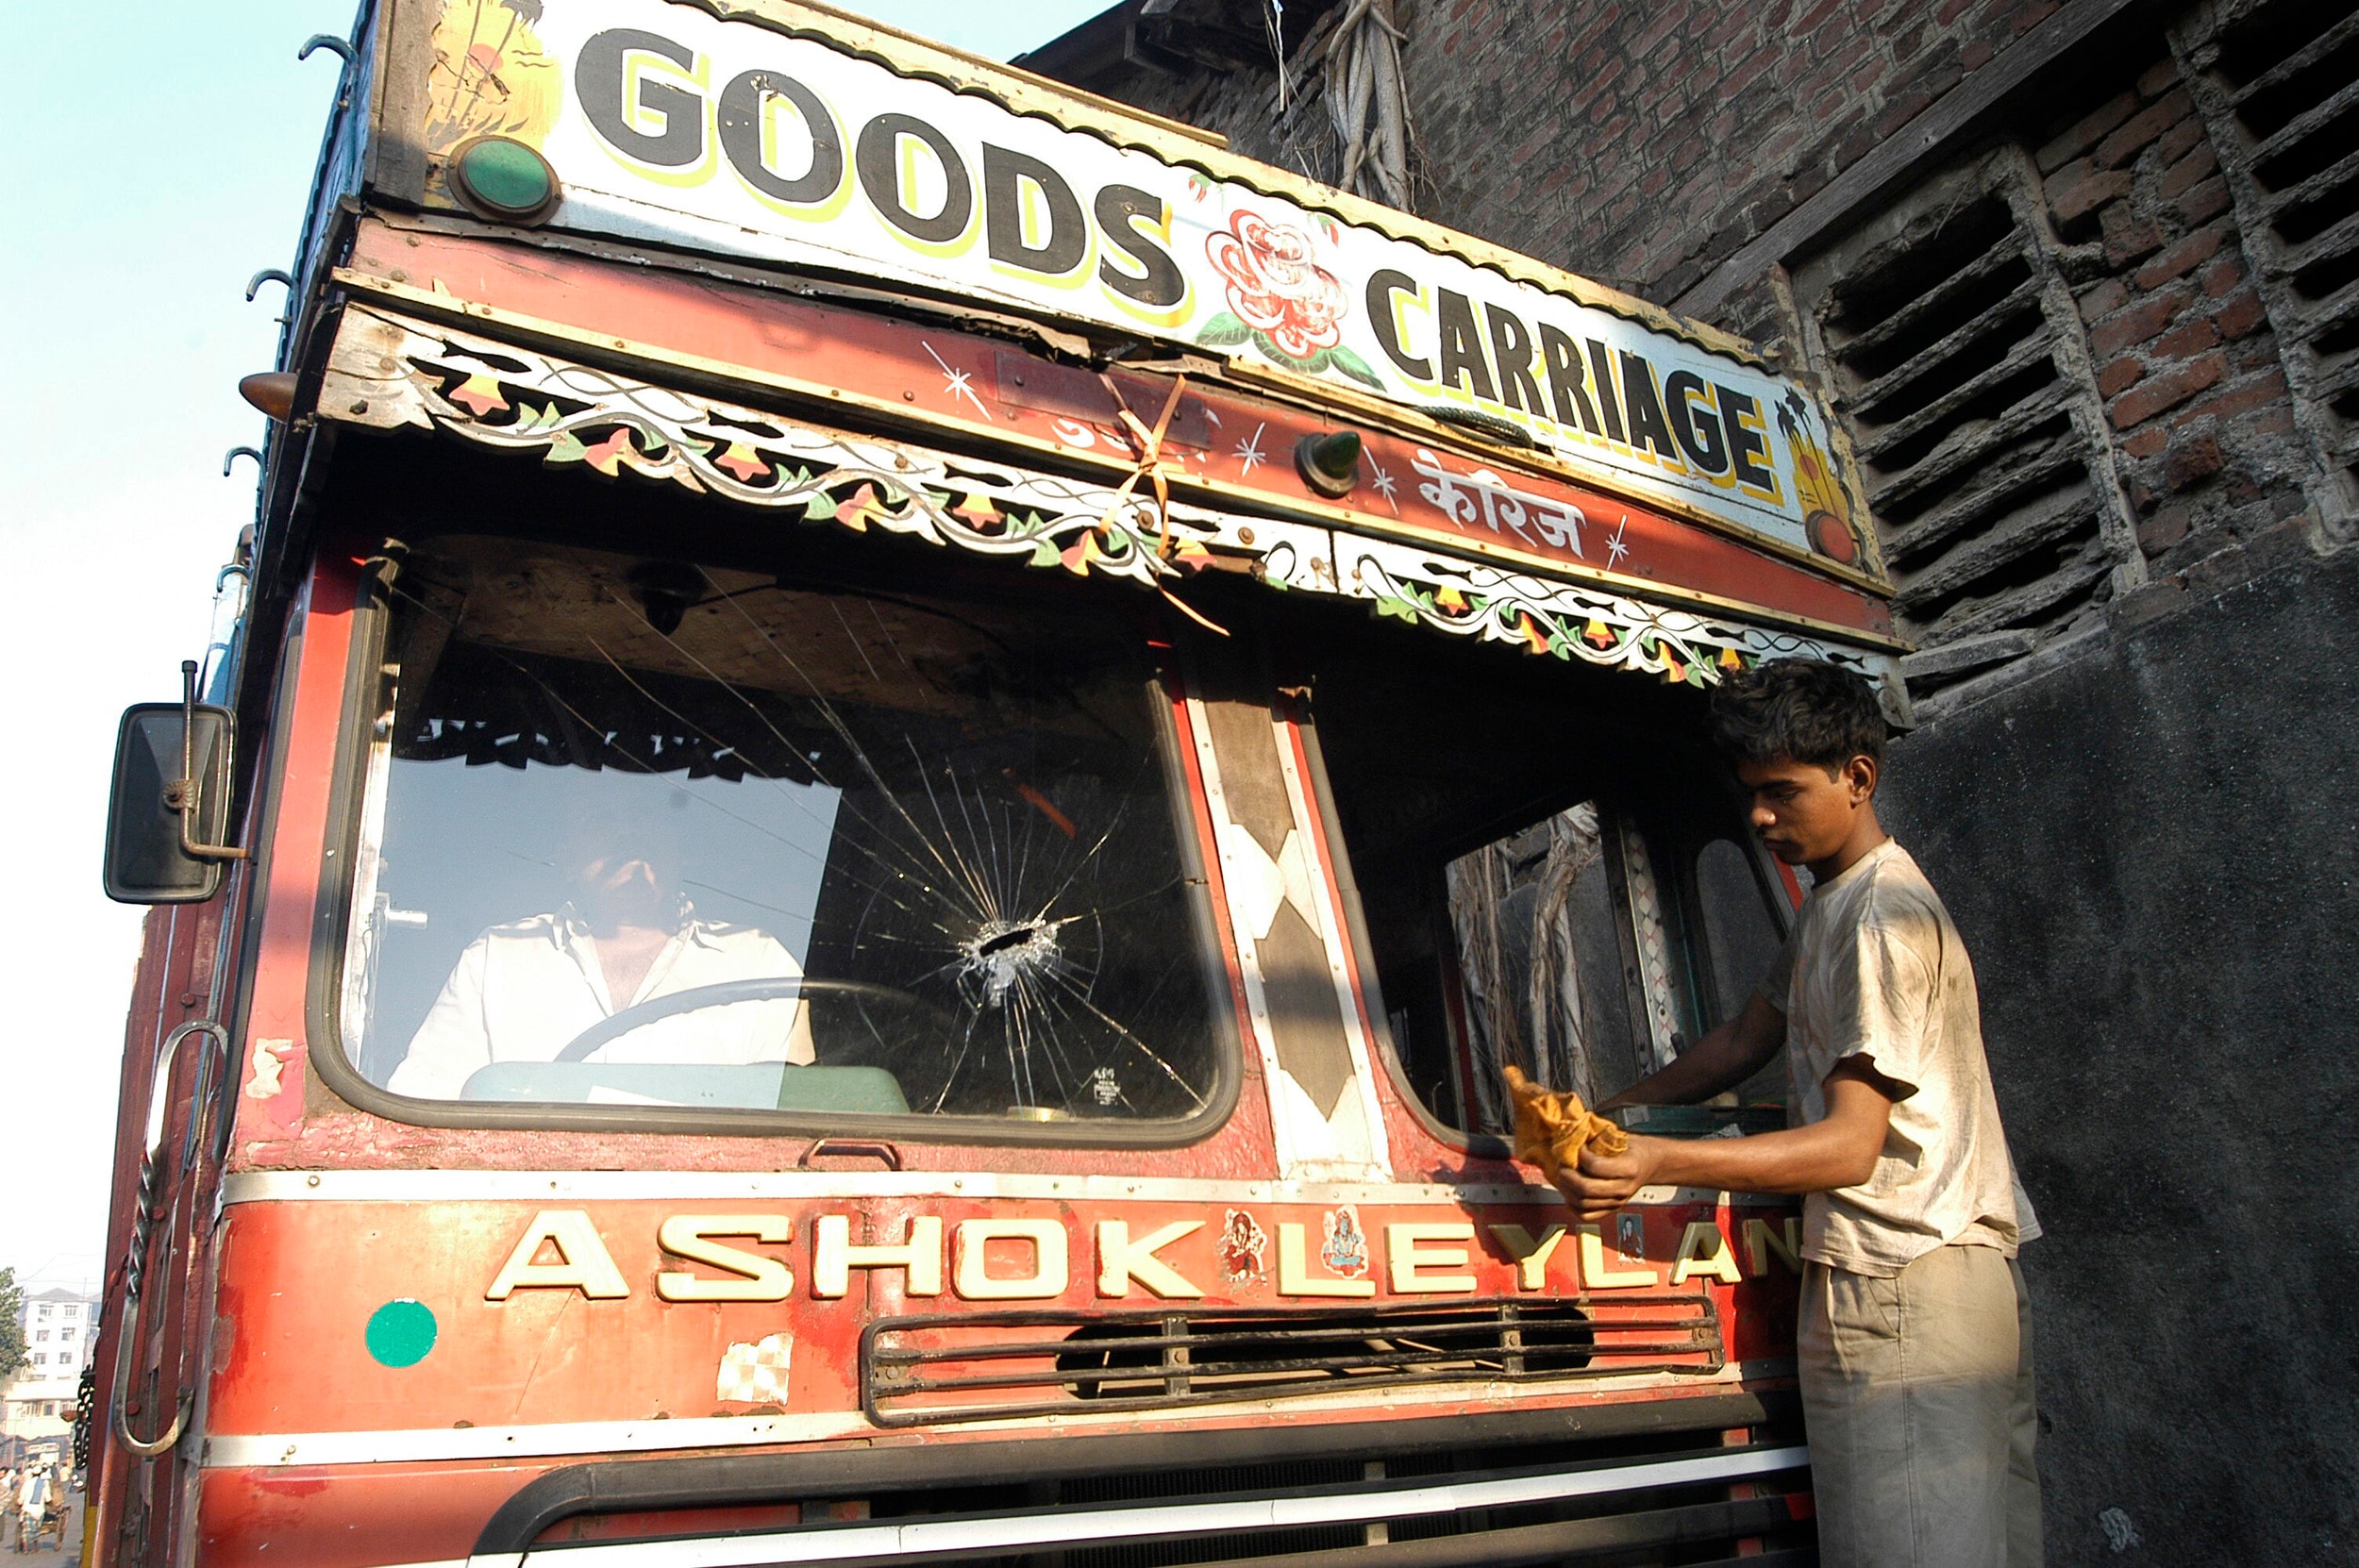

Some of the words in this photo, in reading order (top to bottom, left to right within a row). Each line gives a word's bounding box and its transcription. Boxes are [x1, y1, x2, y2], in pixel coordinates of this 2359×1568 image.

[575, 27, 1191, 319] GOODS
[1366, 268, 1780, 501] CARRIAGE
[484, 1209, 1207, 1302] ASHOK
[1275, 1216, 1802, 1298] LEYLAN
